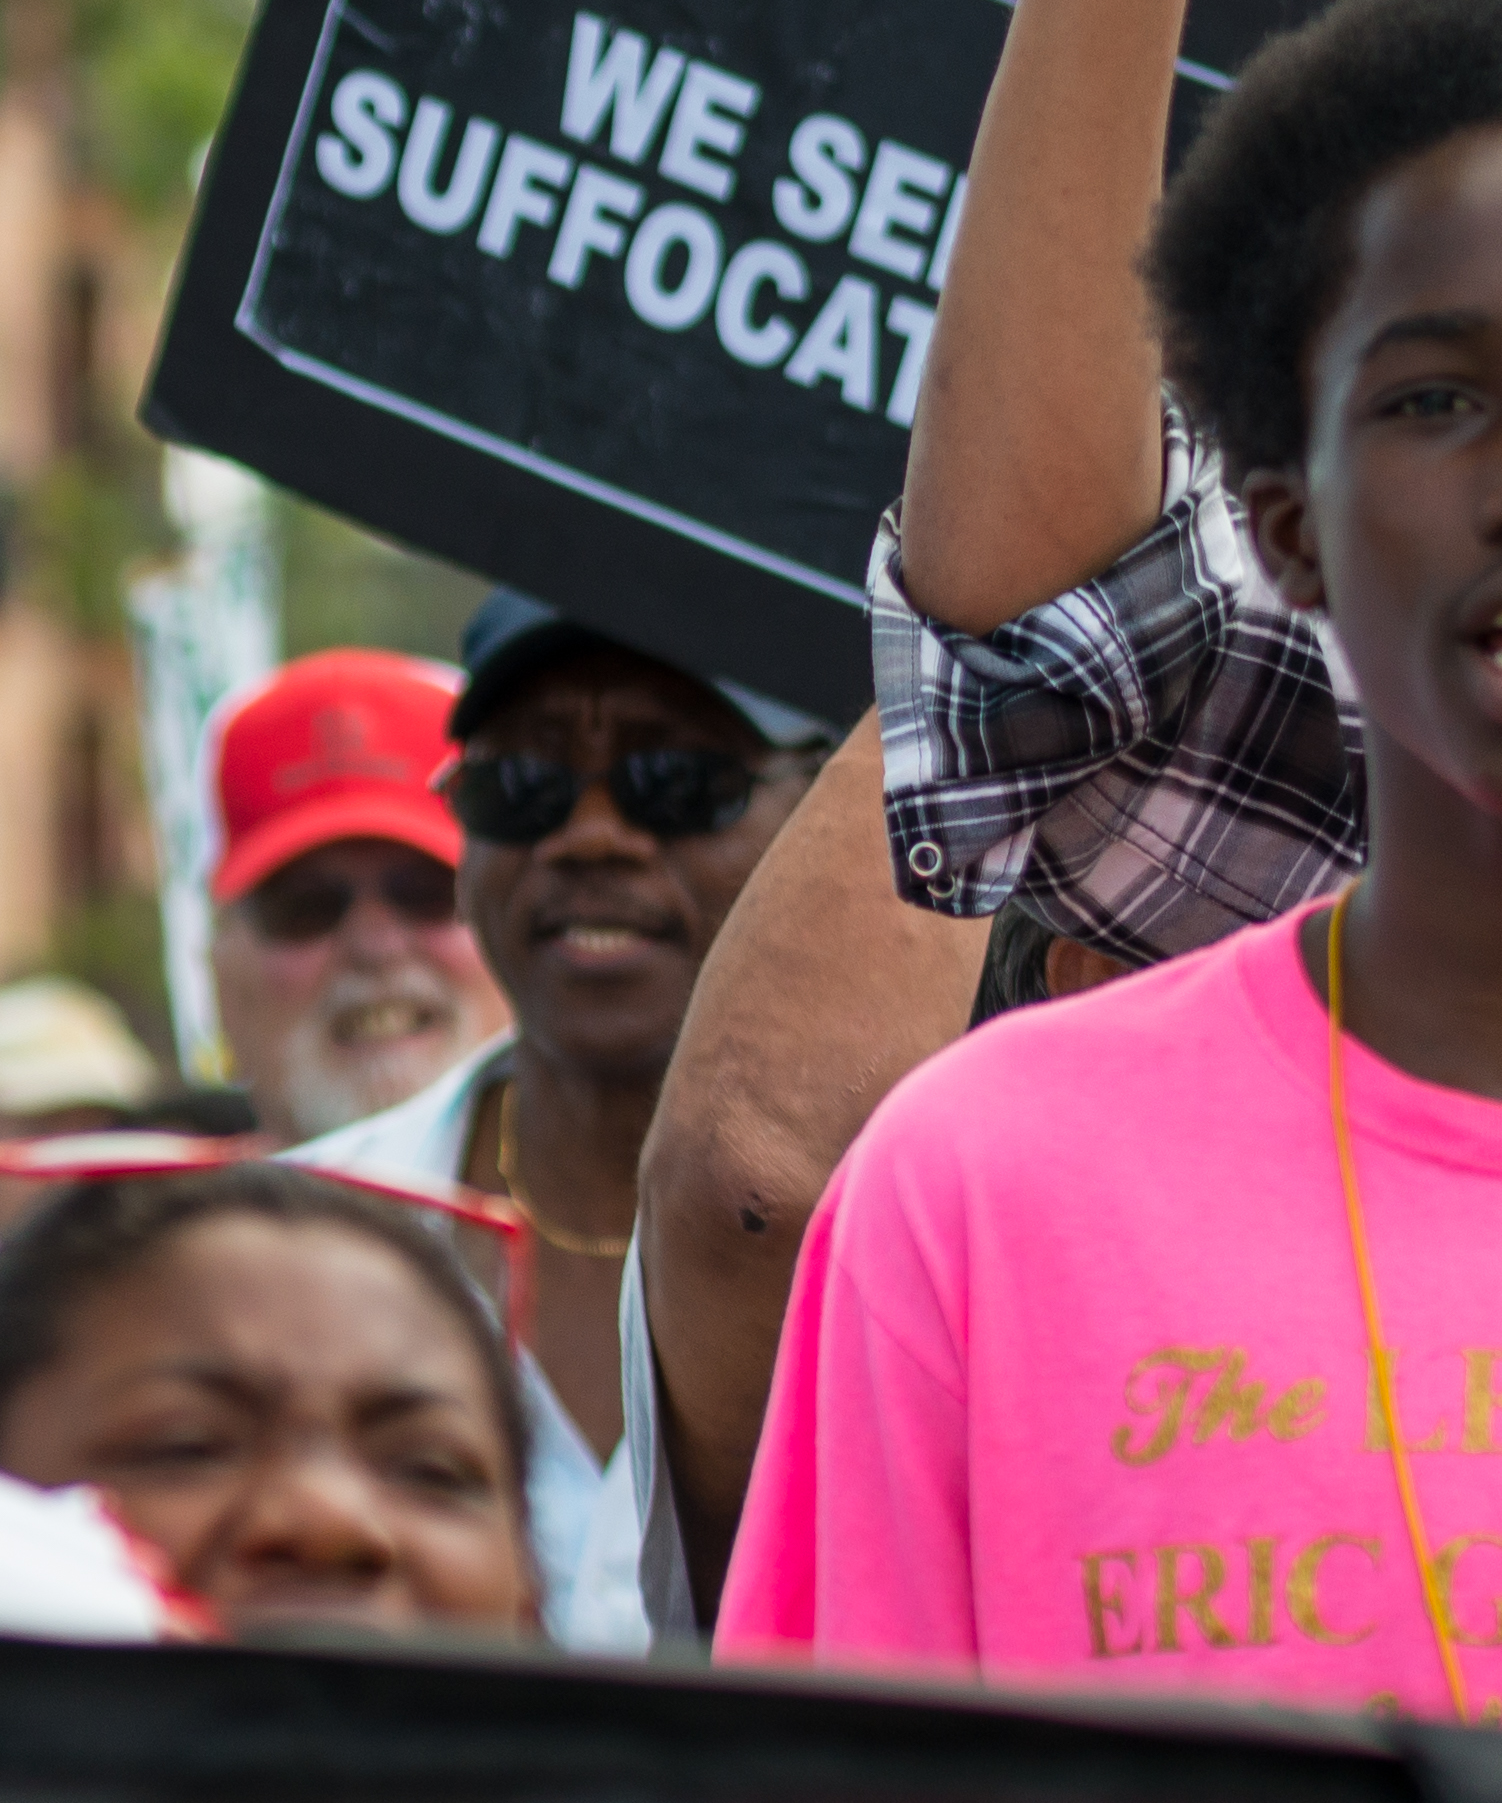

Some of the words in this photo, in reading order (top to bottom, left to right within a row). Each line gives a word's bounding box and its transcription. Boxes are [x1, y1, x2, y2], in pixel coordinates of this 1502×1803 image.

[559, 10, 761, 201] WE
[771, 110, 968, 293] SE
[1110, 1345, 1329, 1467] The
[1079, 1534, 1385, 1659] ERIC
